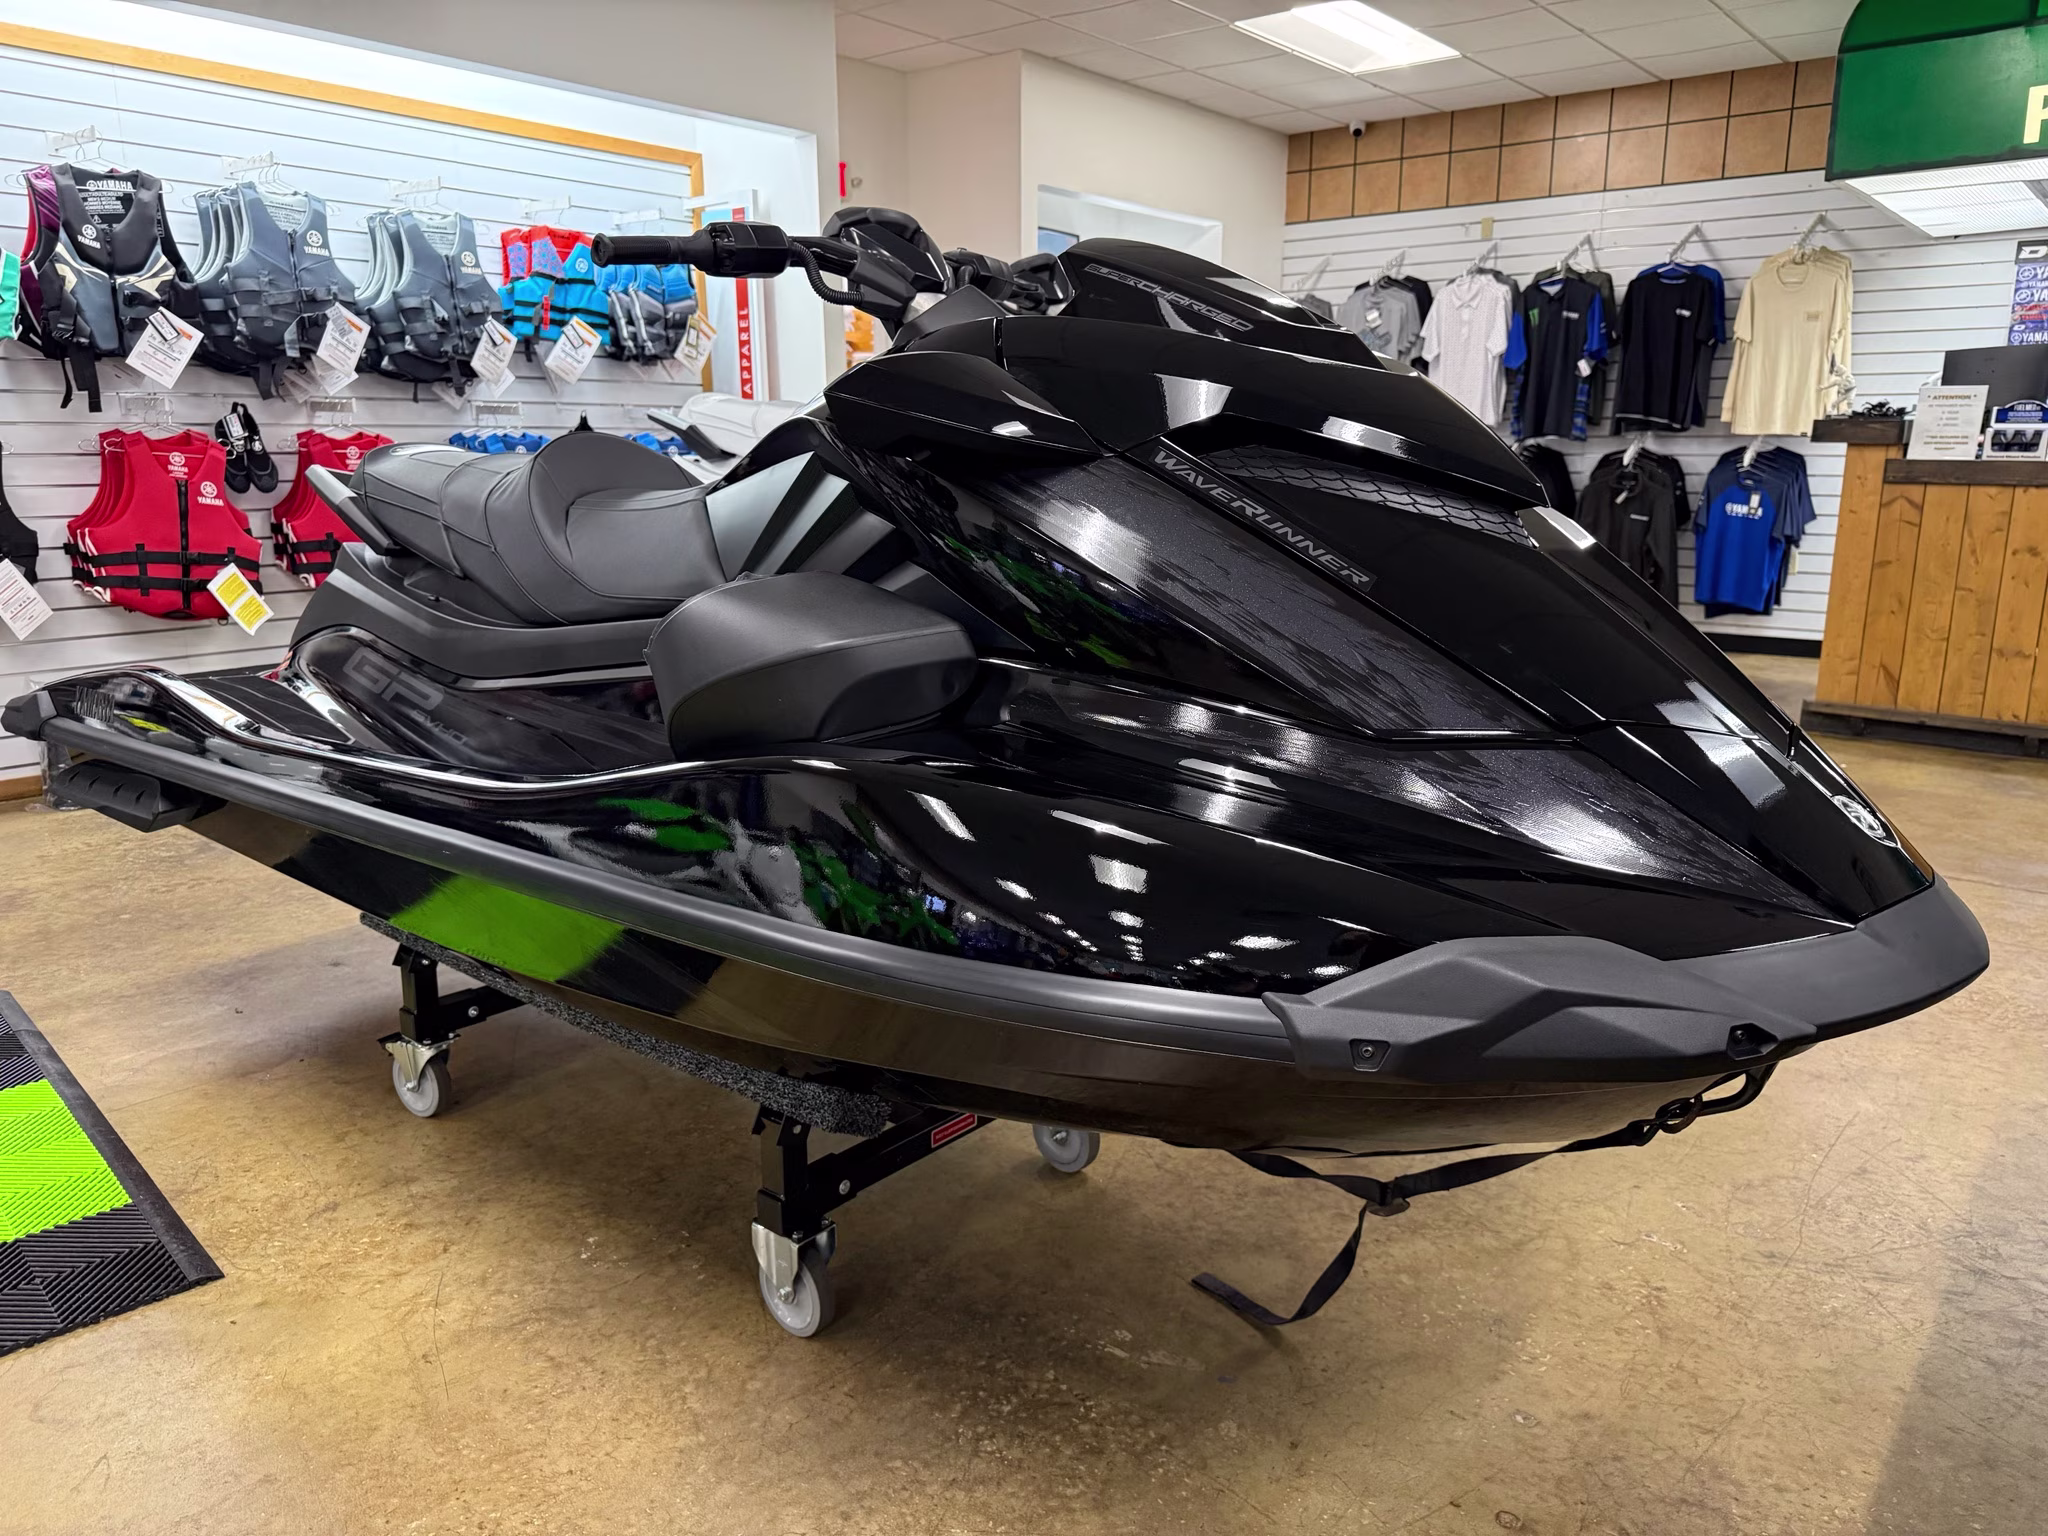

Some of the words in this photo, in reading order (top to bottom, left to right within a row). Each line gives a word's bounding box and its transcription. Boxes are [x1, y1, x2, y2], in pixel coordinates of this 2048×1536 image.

[97, 180, 134, 191] YAMAHA
[77, 234, 101, 249] YAMAHA
[304, 245, 330, 257] YAMAHA
[1084, 263, 1254, 332] SUPERCHARGED
[739, 307, 753, 395] APPAREL
[197, 496, 224, 507] YAMAHA
[1154, 451, 1370, 585] WAVERUNNER
[343, 645, 444, 711] GP
